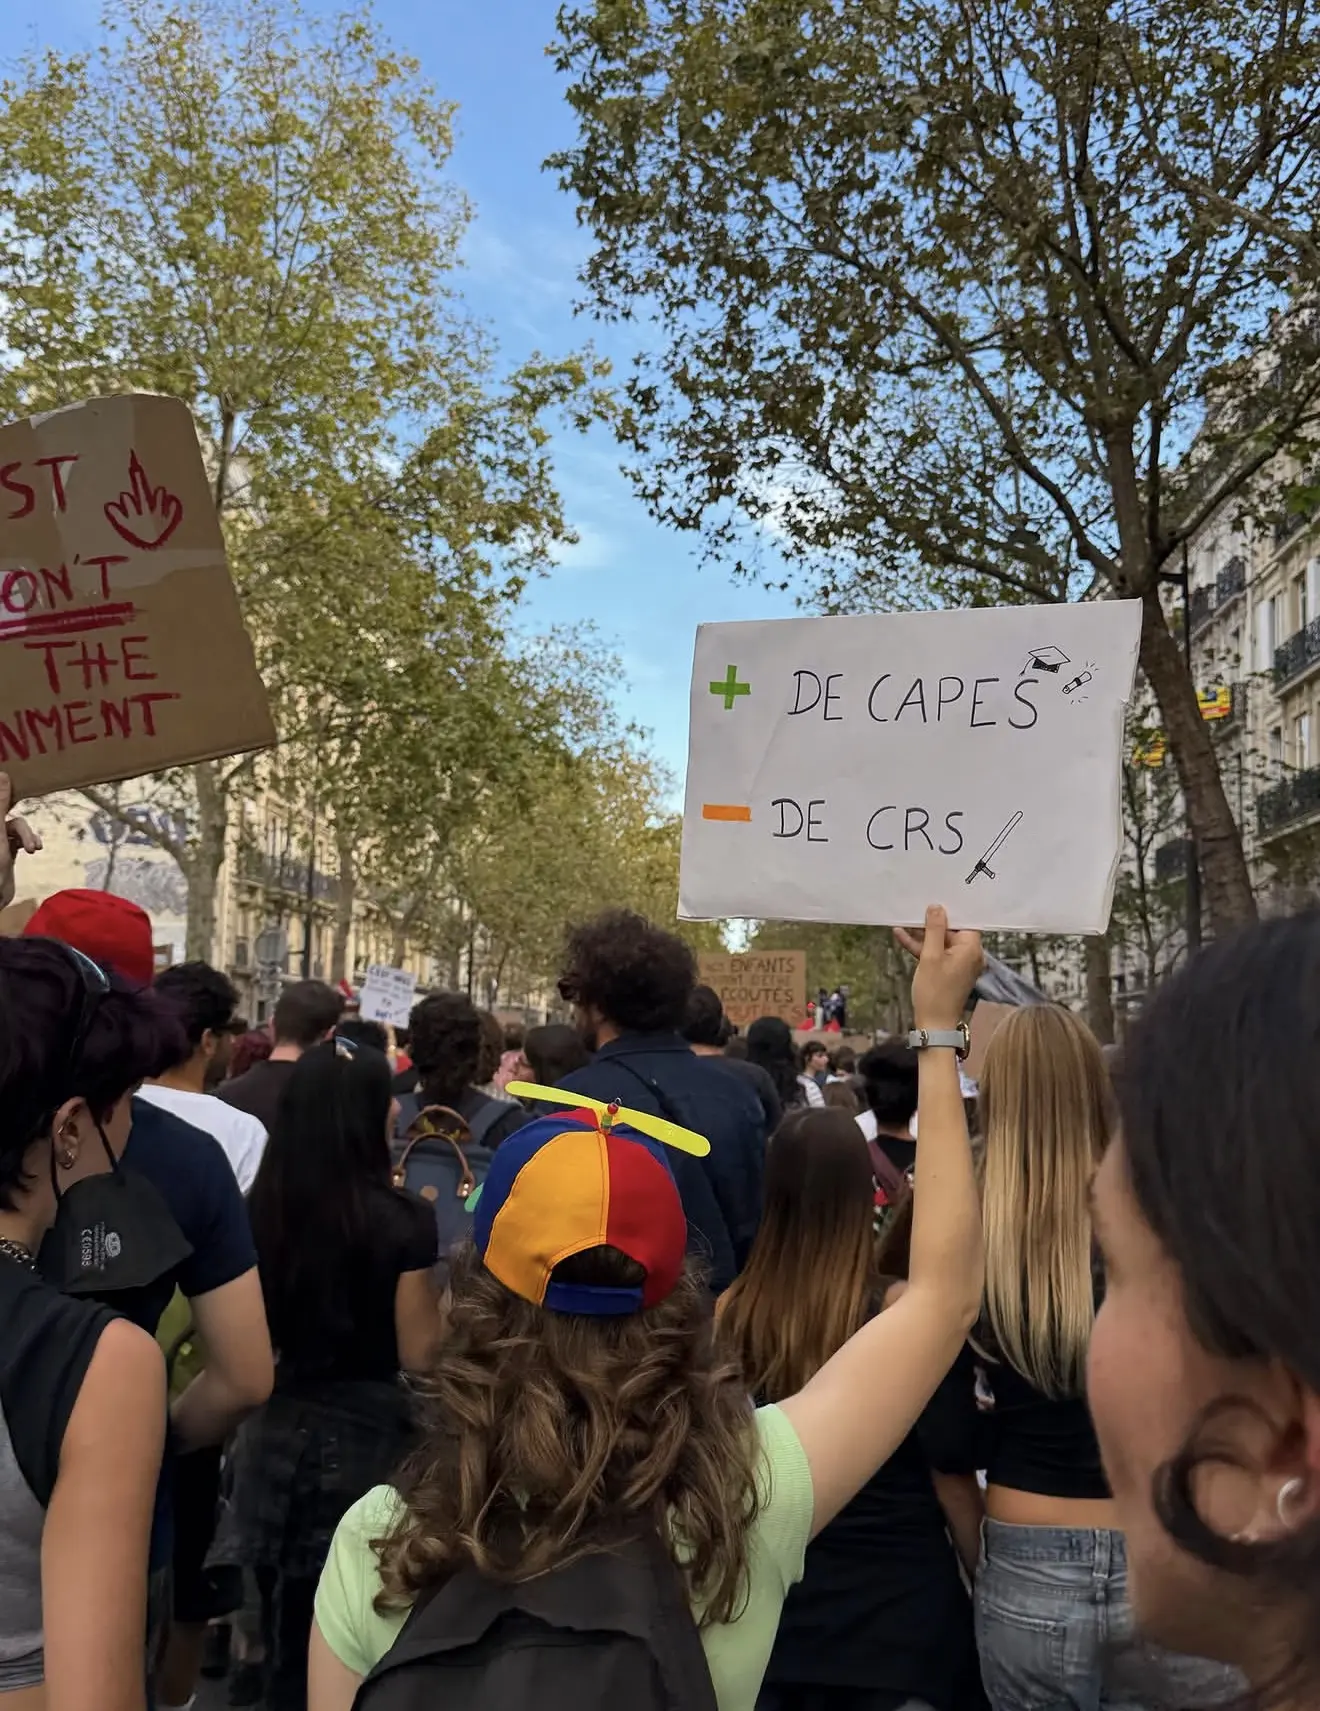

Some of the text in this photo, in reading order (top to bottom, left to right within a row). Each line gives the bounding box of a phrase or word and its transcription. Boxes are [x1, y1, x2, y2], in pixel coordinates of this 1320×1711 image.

[0, 454, 80, 520] ST
[0, 554, 129, 613] ON'T
[24, 635, 159, 694] THE
[787, 669, 844, 721] DE
[0, 691, 181, 762] NMENT
[771, 797, 829, 843] DE
[866, 805, 964, 855] CRS
